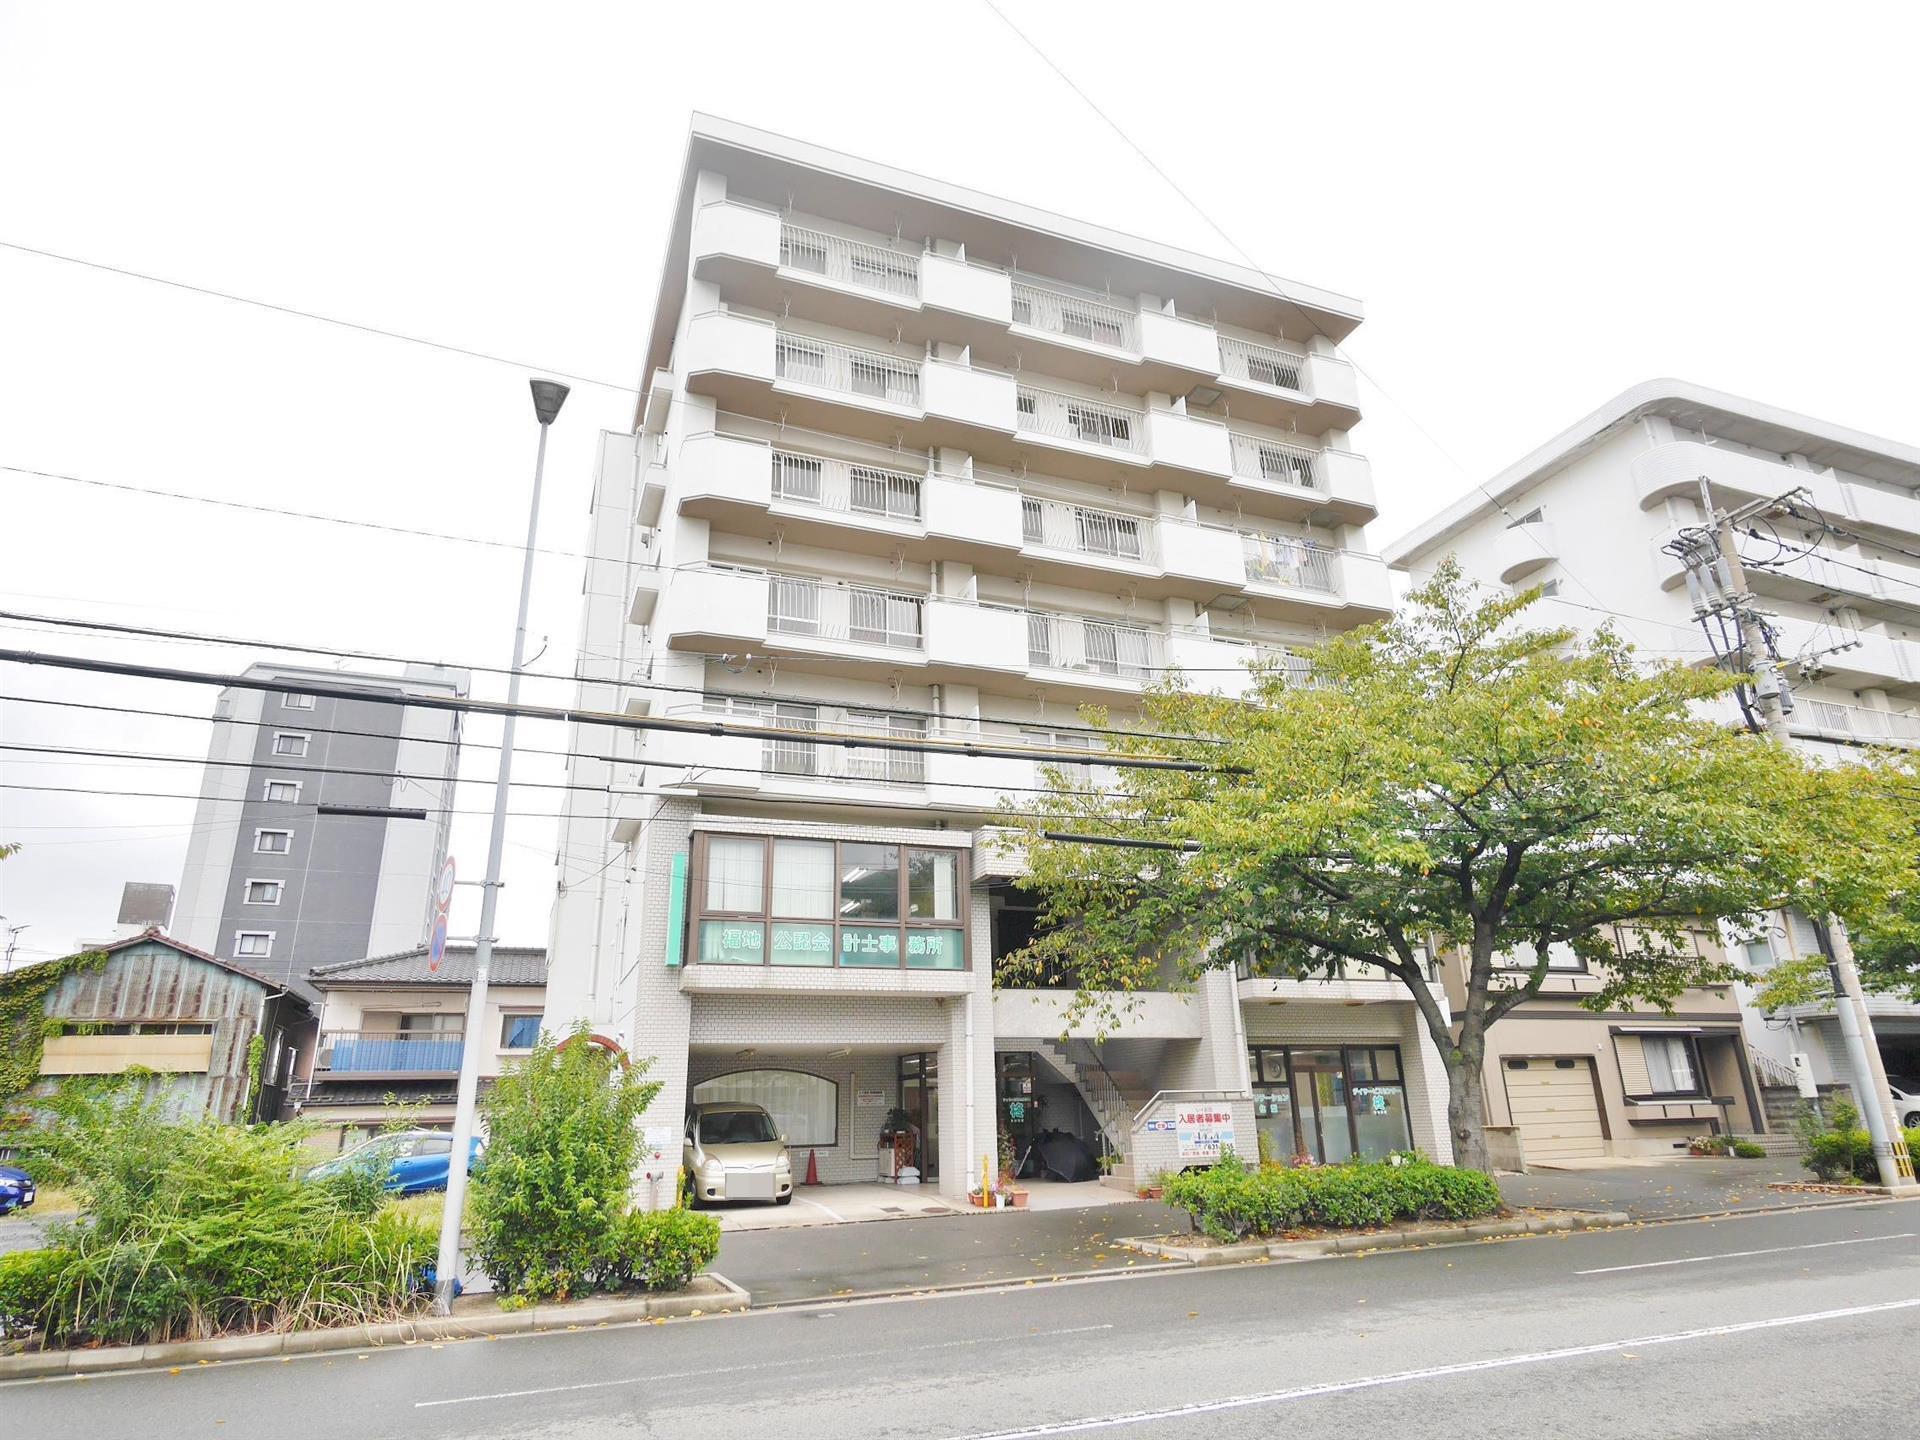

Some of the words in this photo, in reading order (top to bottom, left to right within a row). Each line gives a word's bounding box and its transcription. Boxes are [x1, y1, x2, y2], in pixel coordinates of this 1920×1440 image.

[1179, 1113, 1231, 1124] 入居者募集中
